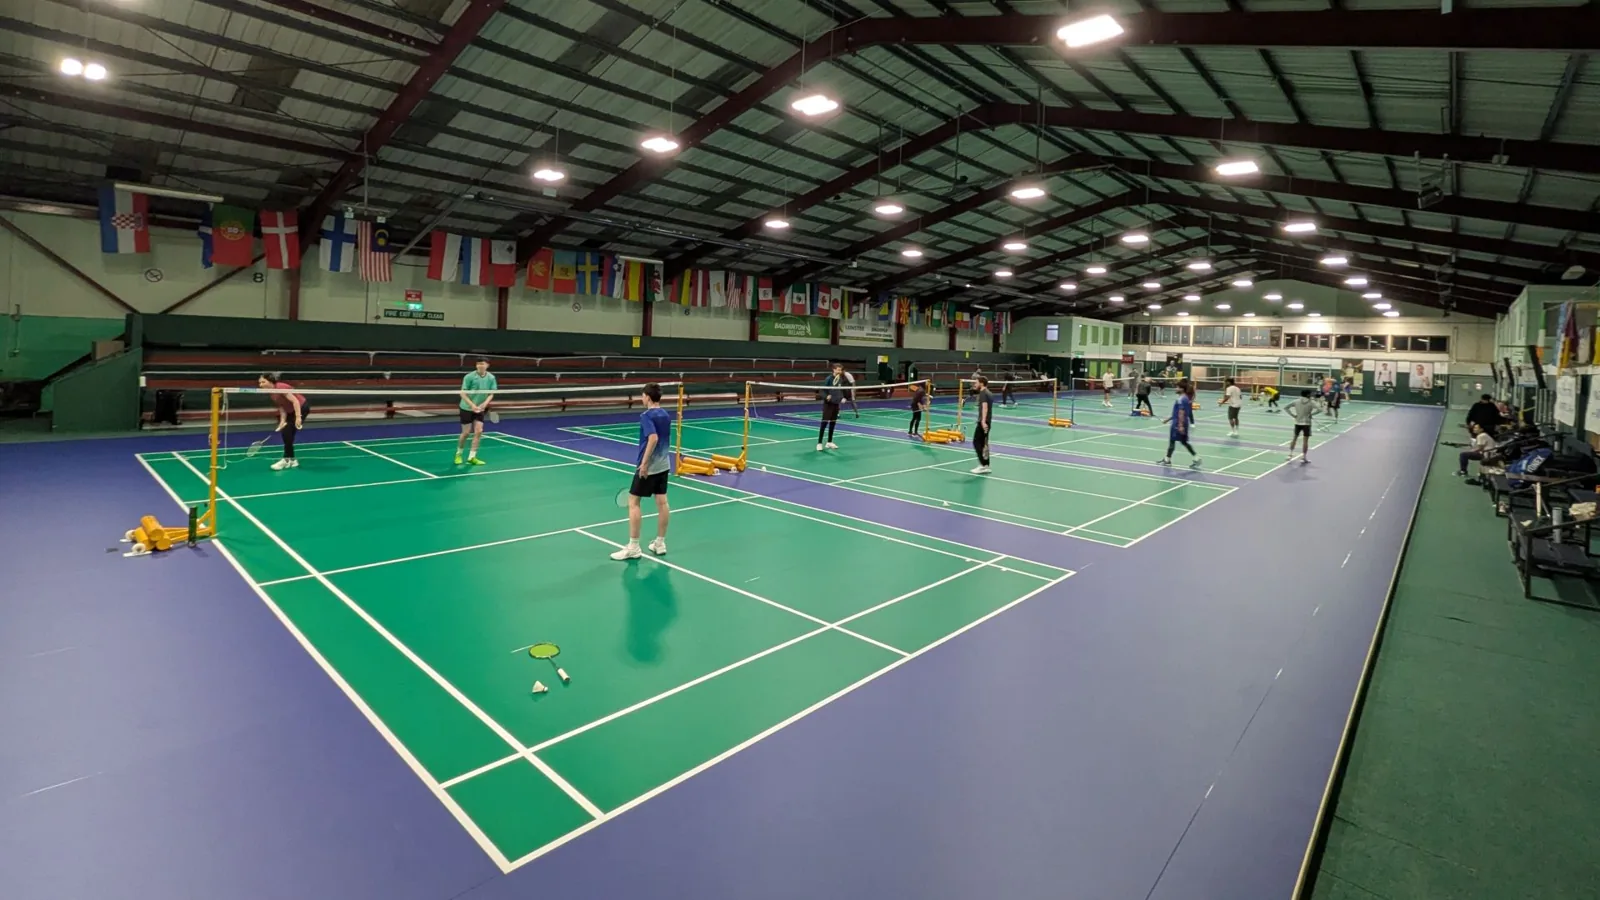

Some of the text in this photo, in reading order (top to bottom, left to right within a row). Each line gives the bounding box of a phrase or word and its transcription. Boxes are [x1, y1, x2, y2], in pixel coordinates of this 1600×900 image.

[253, 272, 264, 283] 8
[774, 322, 806, 331] BADMINTON
[1527, 454, 1546, 473] YONEX
